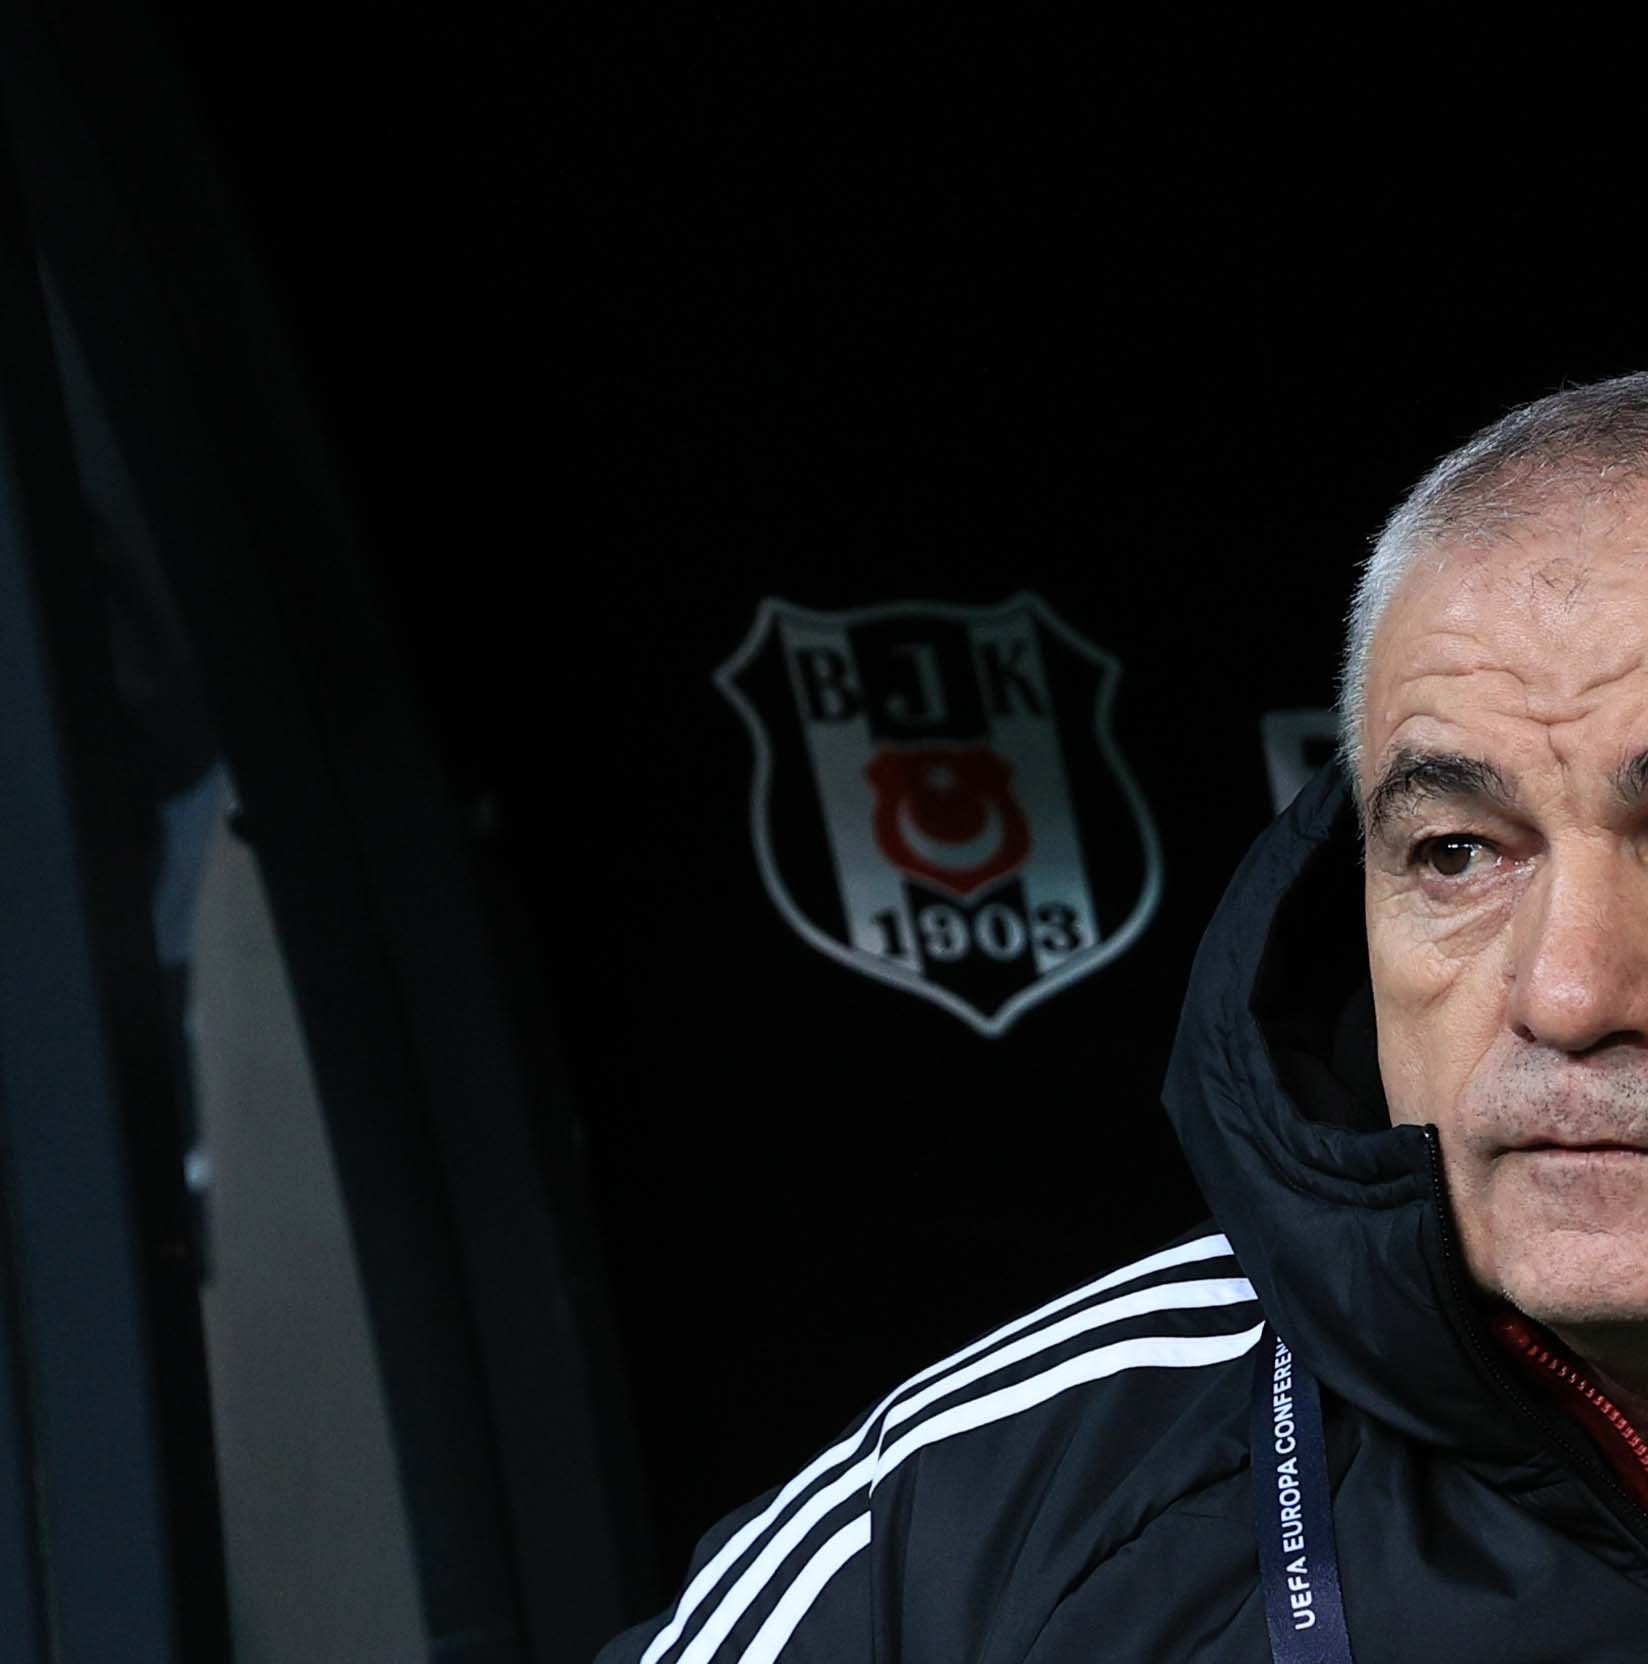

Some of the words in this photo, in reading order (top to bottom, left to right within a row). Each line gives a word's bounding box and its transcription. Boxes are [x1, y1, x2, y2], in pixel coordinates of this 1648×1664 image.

[797, 641, 1055, 728] BJK
[875, 902, 1083, 963] 1903
[1273, 1336, 1297, 1455] CONFEREN
[1276, 1457, 1304, 1552] EUROPA
[1285, 1556, 1316, 1631] UEFA
